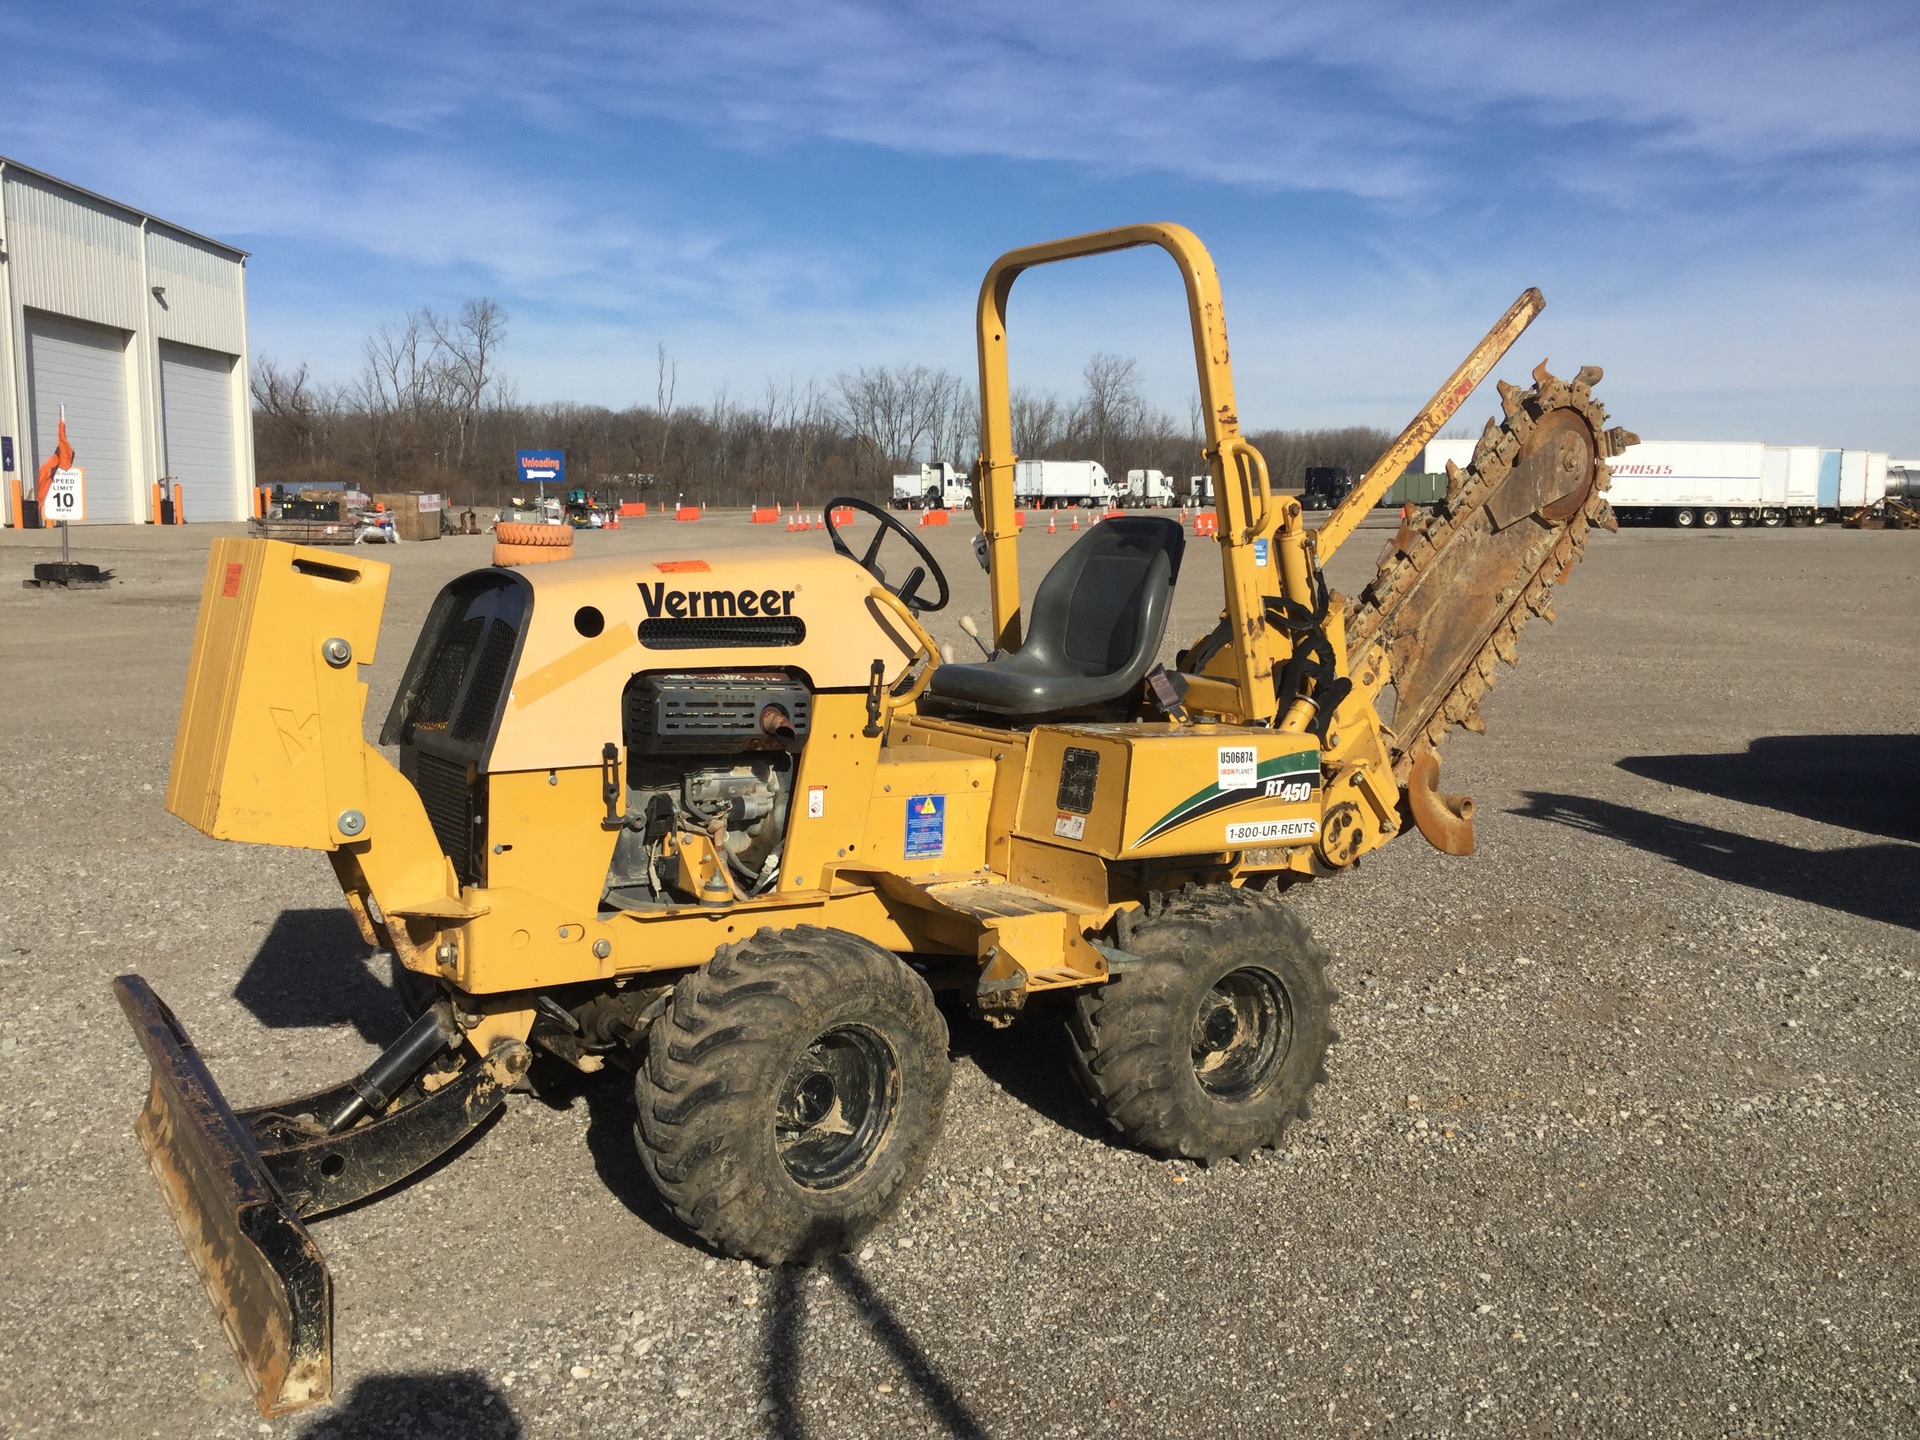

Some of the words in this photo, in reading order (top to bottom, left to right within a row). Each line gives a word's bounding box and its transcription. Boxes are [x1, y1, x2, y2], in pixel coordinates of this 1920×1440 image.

[521, 457, 560, 471] Unloading
[53, 493, 74, 508] 10
[636, 582, 796, 619] Vermeer
[1220, 751, 1253, 764] U506874
[1265, 780, 1312, 802] RT450
[1229, 821, 1316, 839] 1-800-UR-RENTS
